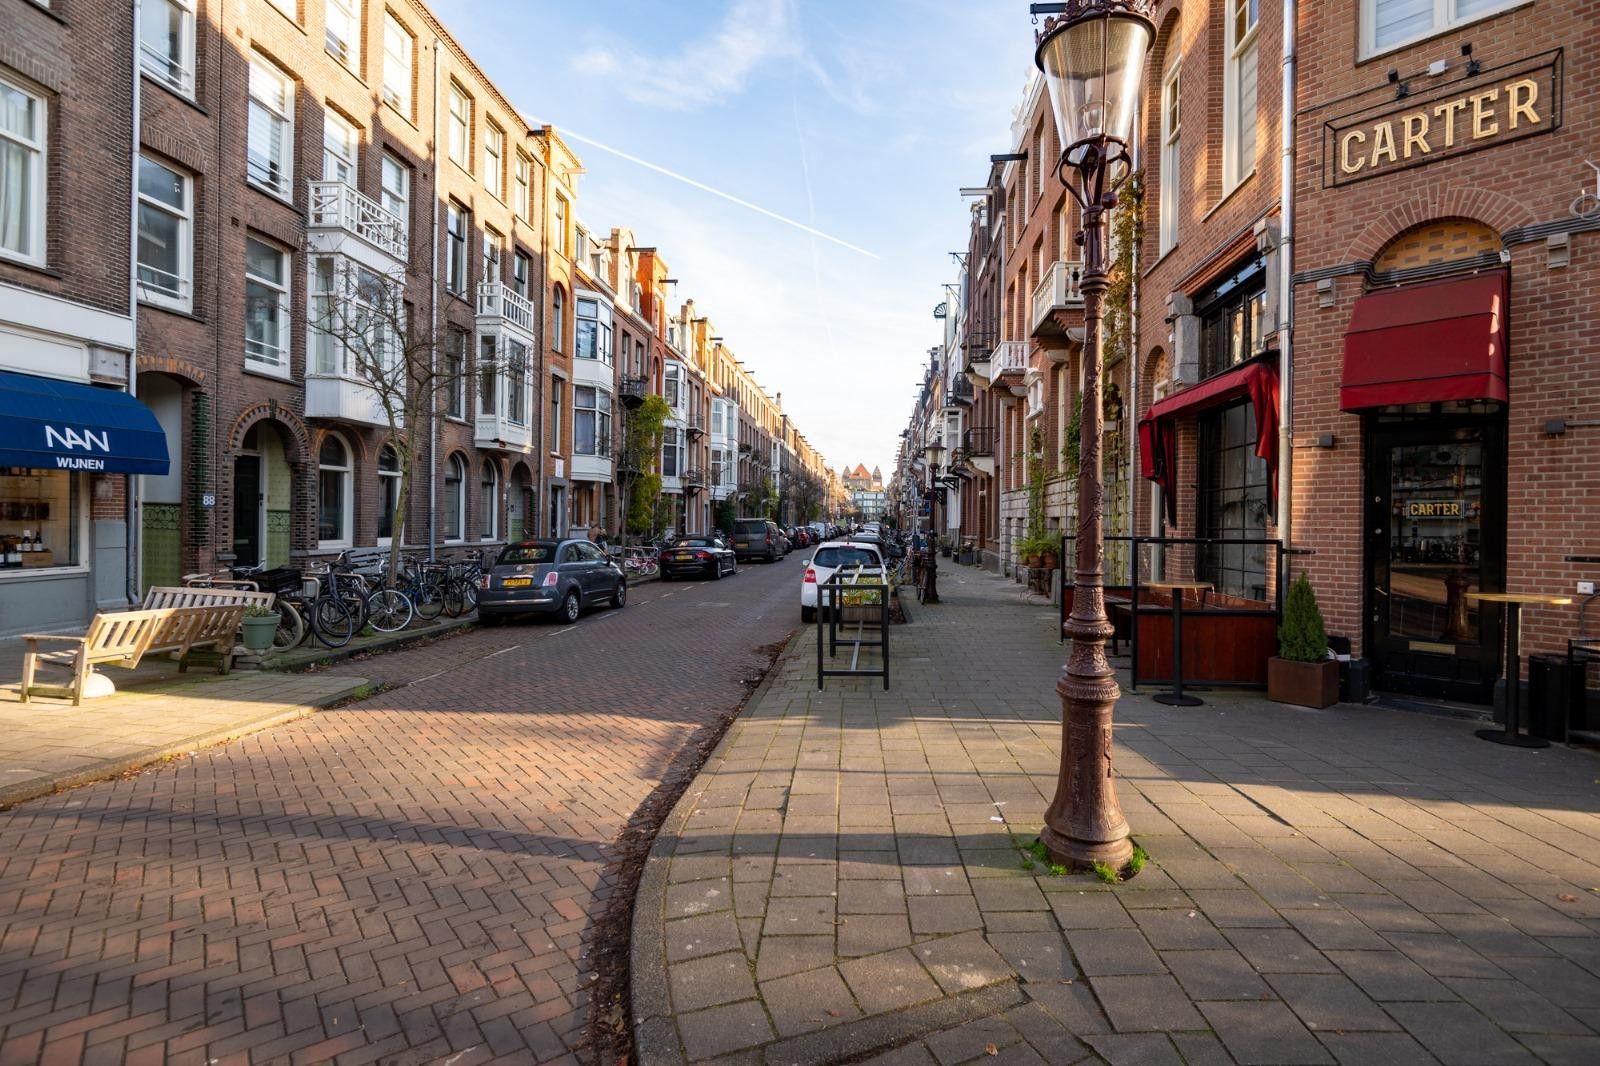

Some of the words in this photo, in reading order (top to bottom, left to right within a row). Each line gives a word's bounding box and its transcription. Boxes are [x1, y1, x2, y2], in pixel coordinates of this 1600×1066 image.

[1341, 78, 1541, 174] CARTER
[45, 425, 110, 452] NAN
[56, 456, 104, 470] WIJNEN
[203, 496, 215, 506] 88
[1410, 503, 1460, 516] CARTER
